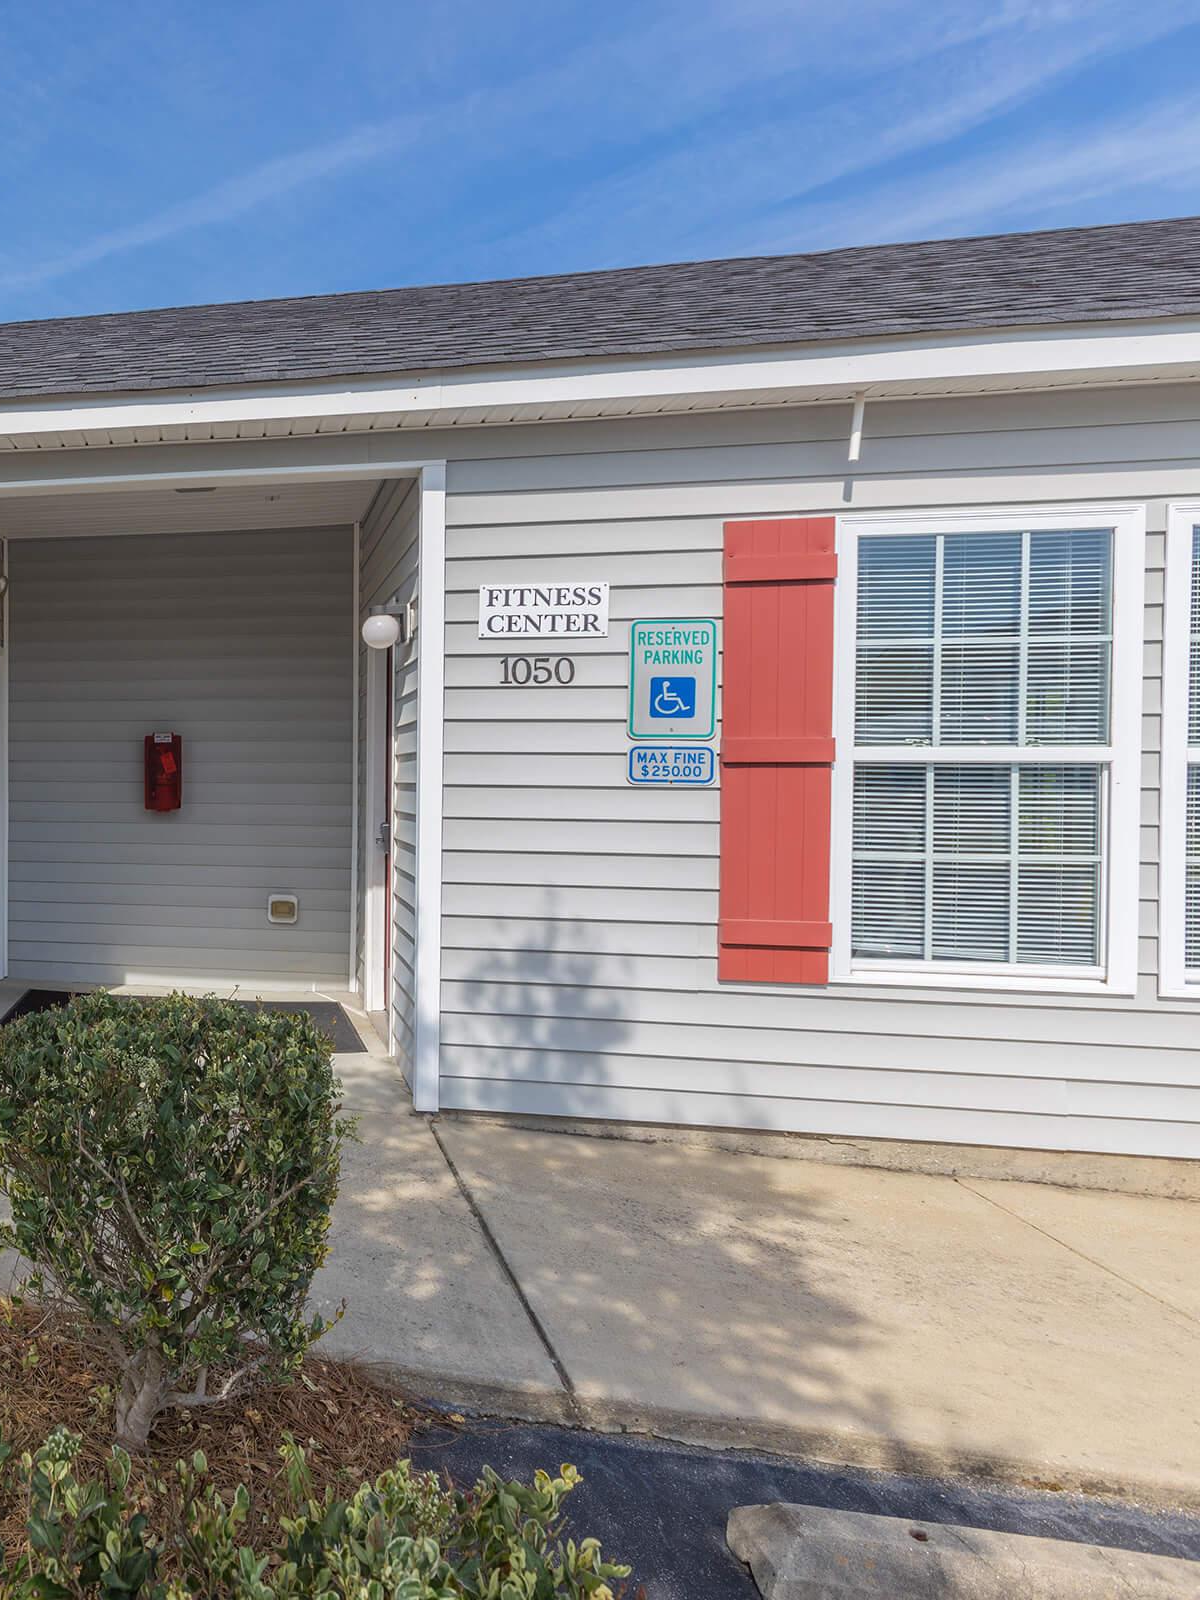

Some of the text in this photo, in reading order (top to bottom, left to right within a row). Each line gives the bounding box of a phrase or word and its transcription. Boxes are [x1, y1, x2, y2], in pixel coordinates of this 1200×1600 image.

[486, 587, 602, 607] FITNESS
[486, 614, 601, 633] CENTER
[638, 631, 710, 646] RESERVED
[644, 650, 703, 664] PARKING
[499, 656, 575, 685] 1050
[637, 752, 706, 764] MAX FINE
[641, 765, 702, 777] $250.00
